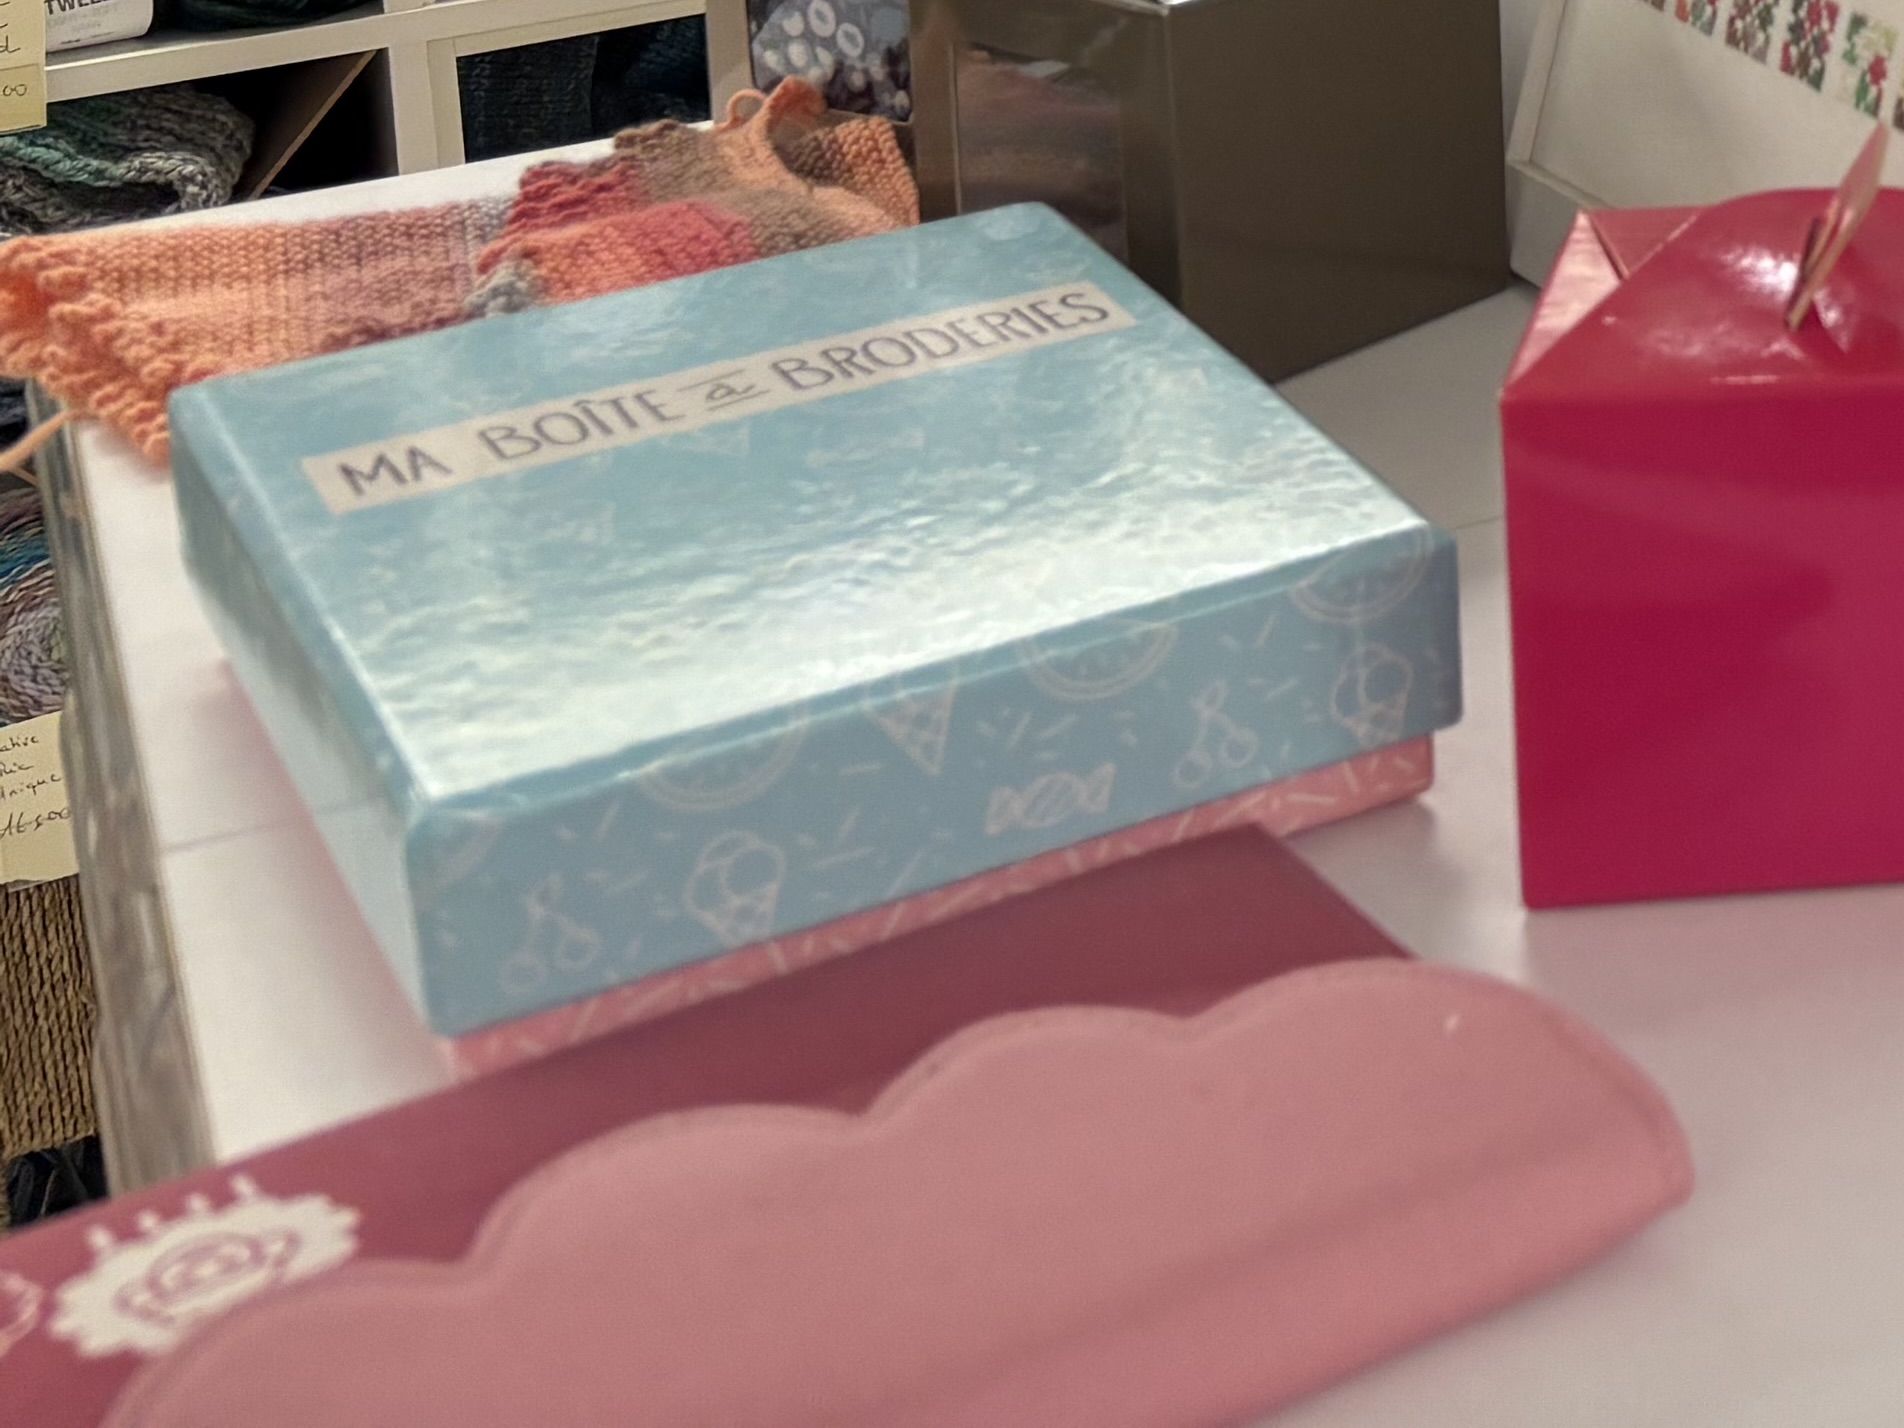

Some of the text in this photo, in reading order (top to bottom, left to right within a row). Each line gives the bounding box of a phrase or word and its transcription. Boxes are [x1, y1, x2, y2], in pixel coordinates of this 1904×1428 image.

[340, 441, 451, 501] MA
[481, 379, 689, 464] BOÎTE
[772, 290, 1114, 394] BRODERIES
